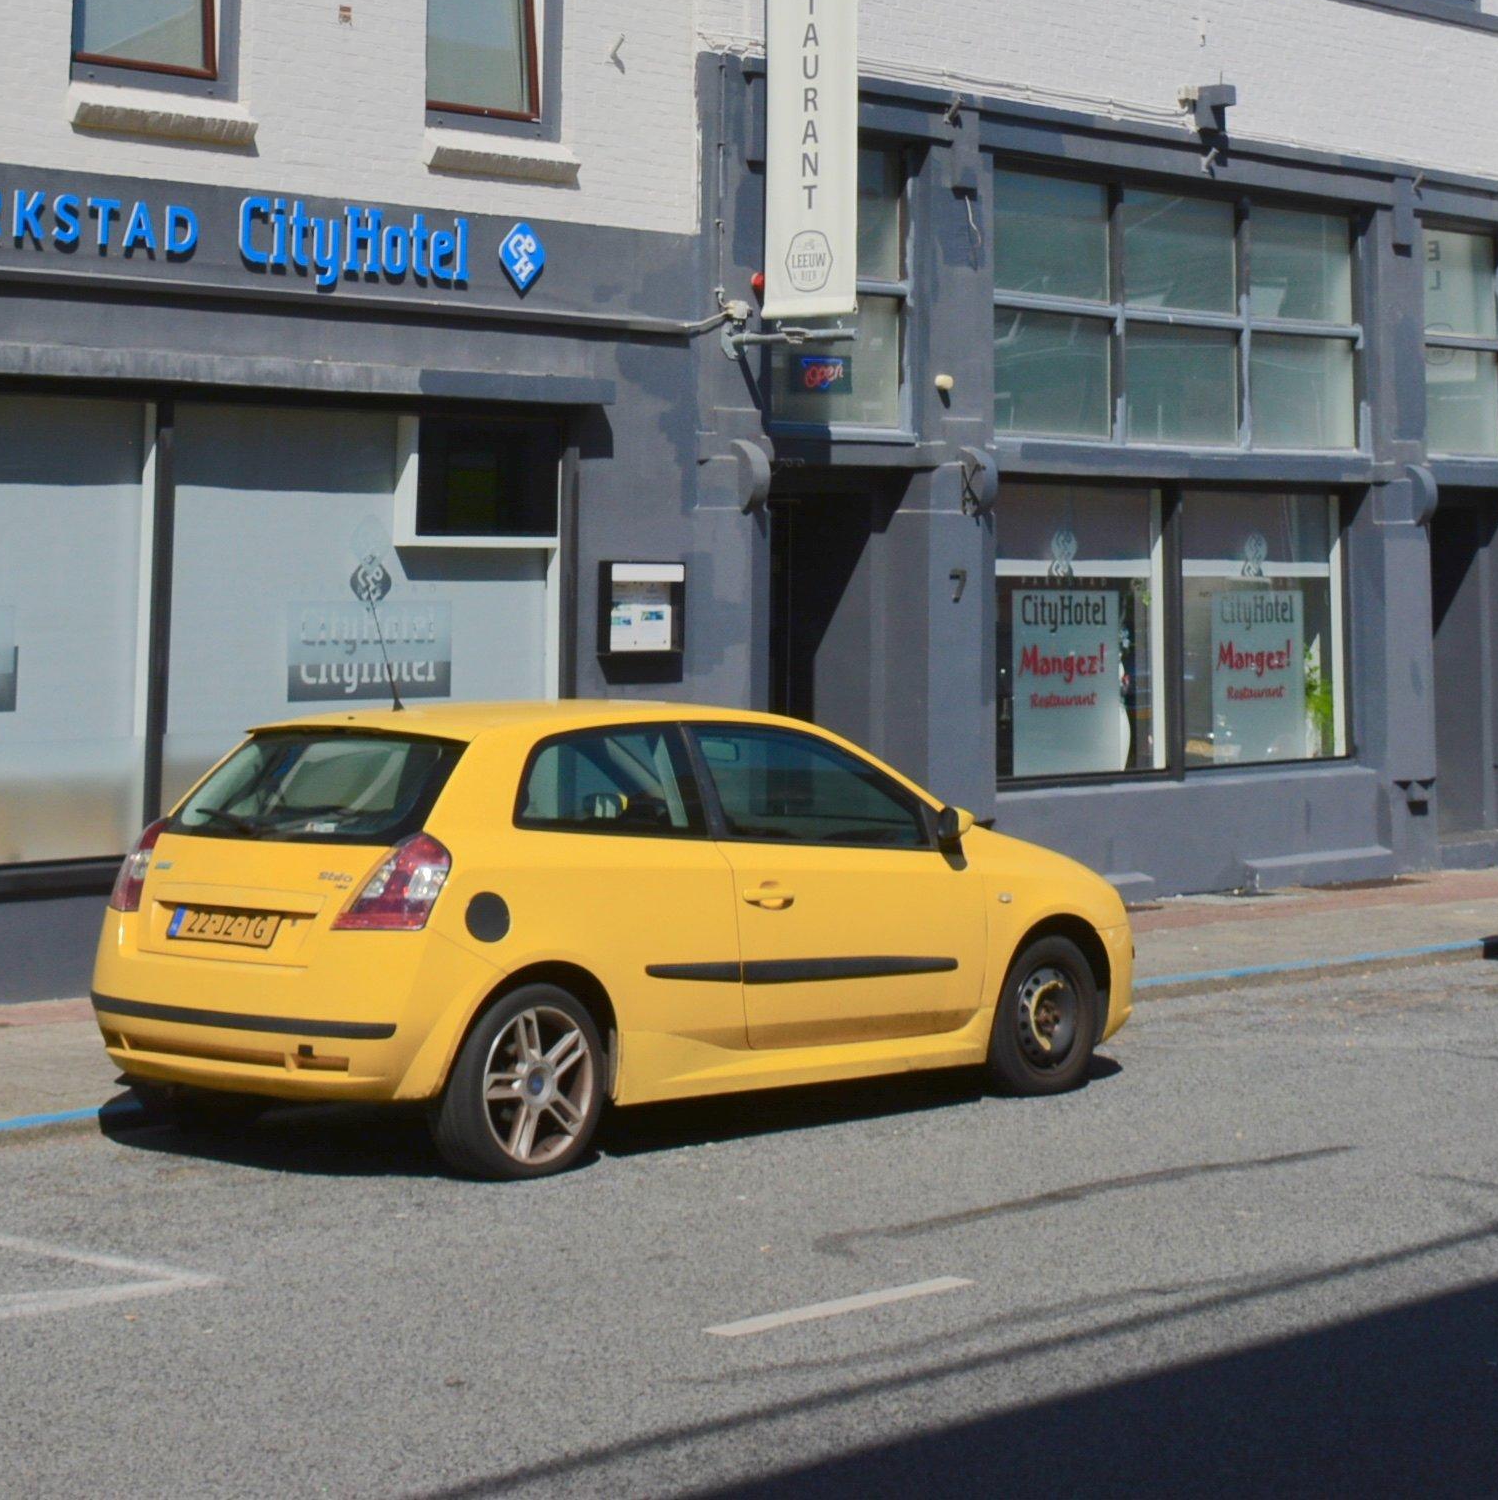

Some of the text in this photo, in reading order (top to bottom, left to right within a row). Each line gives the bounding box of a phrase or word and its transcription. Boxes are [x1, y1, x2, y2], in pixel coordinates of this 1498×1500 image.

[238, 196, 469, 286] CityHotel
[792, 252, 826, 268] LEEUW
[1021, 594, 1107, 633] CityHotel
[1220, 595, 1294, 631] CityHotel
[1018, 643, 1106, 684] Mangez!
[1216, 639, 1292, 678] Mangez!
[1030, 692, 1098, 709] Restaurant
[1226, 686, 1286, 701] Restaurant
